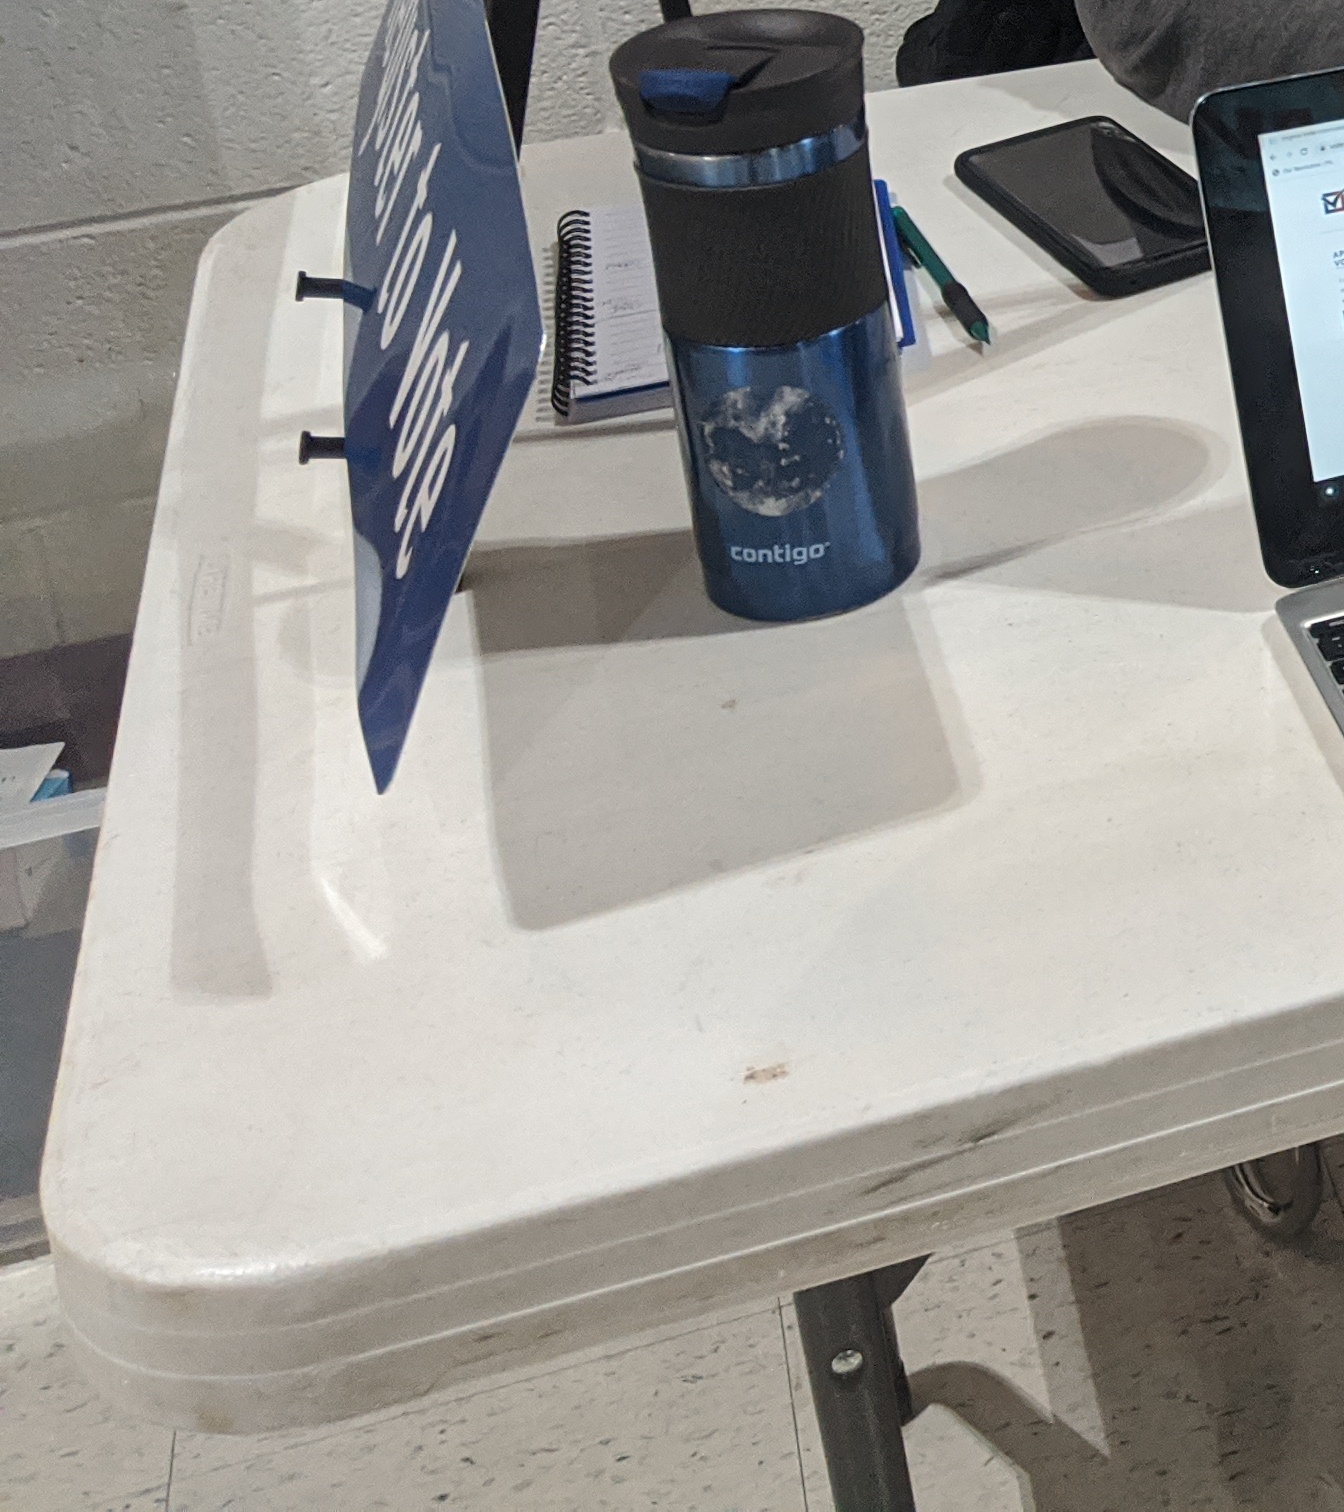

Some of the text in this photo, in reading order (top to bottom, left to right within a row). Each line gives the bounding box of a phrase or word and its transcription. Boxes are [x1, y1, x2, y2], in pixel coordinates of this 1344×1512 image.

[378, 144, 441, 349] to
[389, 231, 469, 578] Vote
[731, 542, 827, 565] contigo
